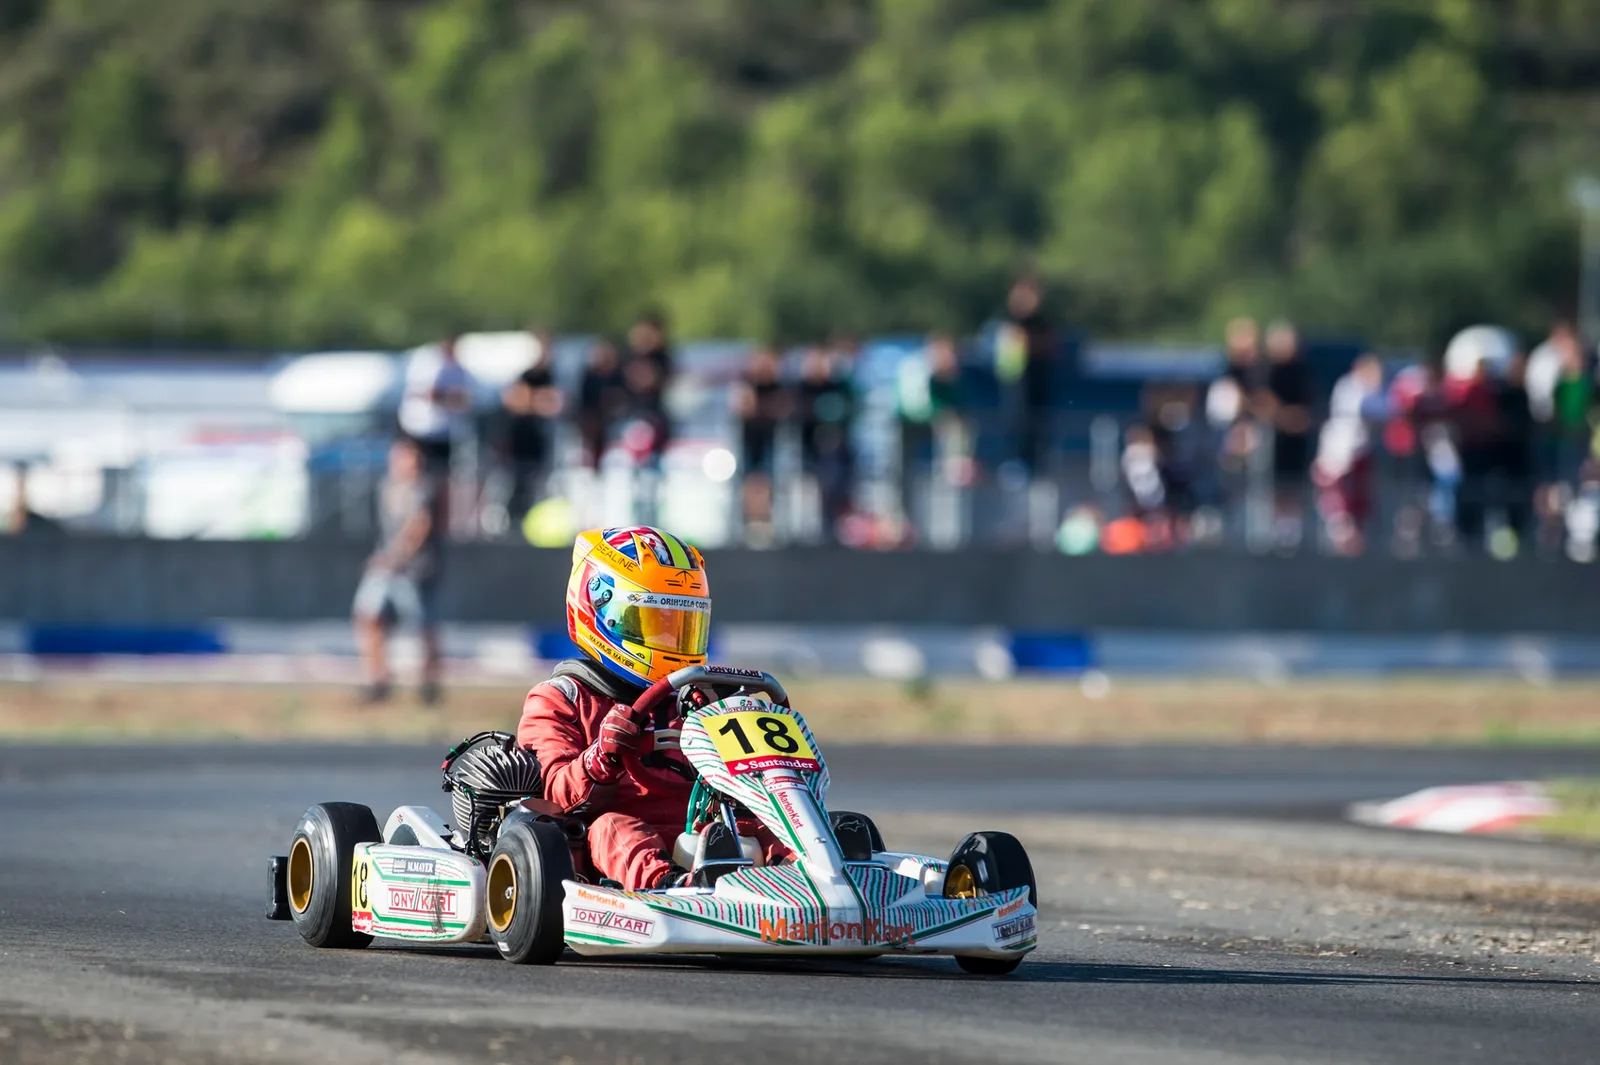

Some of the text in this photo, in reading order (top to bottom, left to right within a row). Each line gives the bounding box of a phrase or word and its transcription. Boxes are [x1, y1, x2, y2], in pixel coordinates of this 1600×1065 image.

[596, 543, 637, 572] SEALINE
[660, 597, 694, 607] ORIHUELA
[719, 717, 799, 755] 18
[749, 759, 814, 770] Santander
[778, 791, 804, 829] MarionKart
[353, 861, 368, 909] 18
[760, 916, 916, 945] MarionKart
